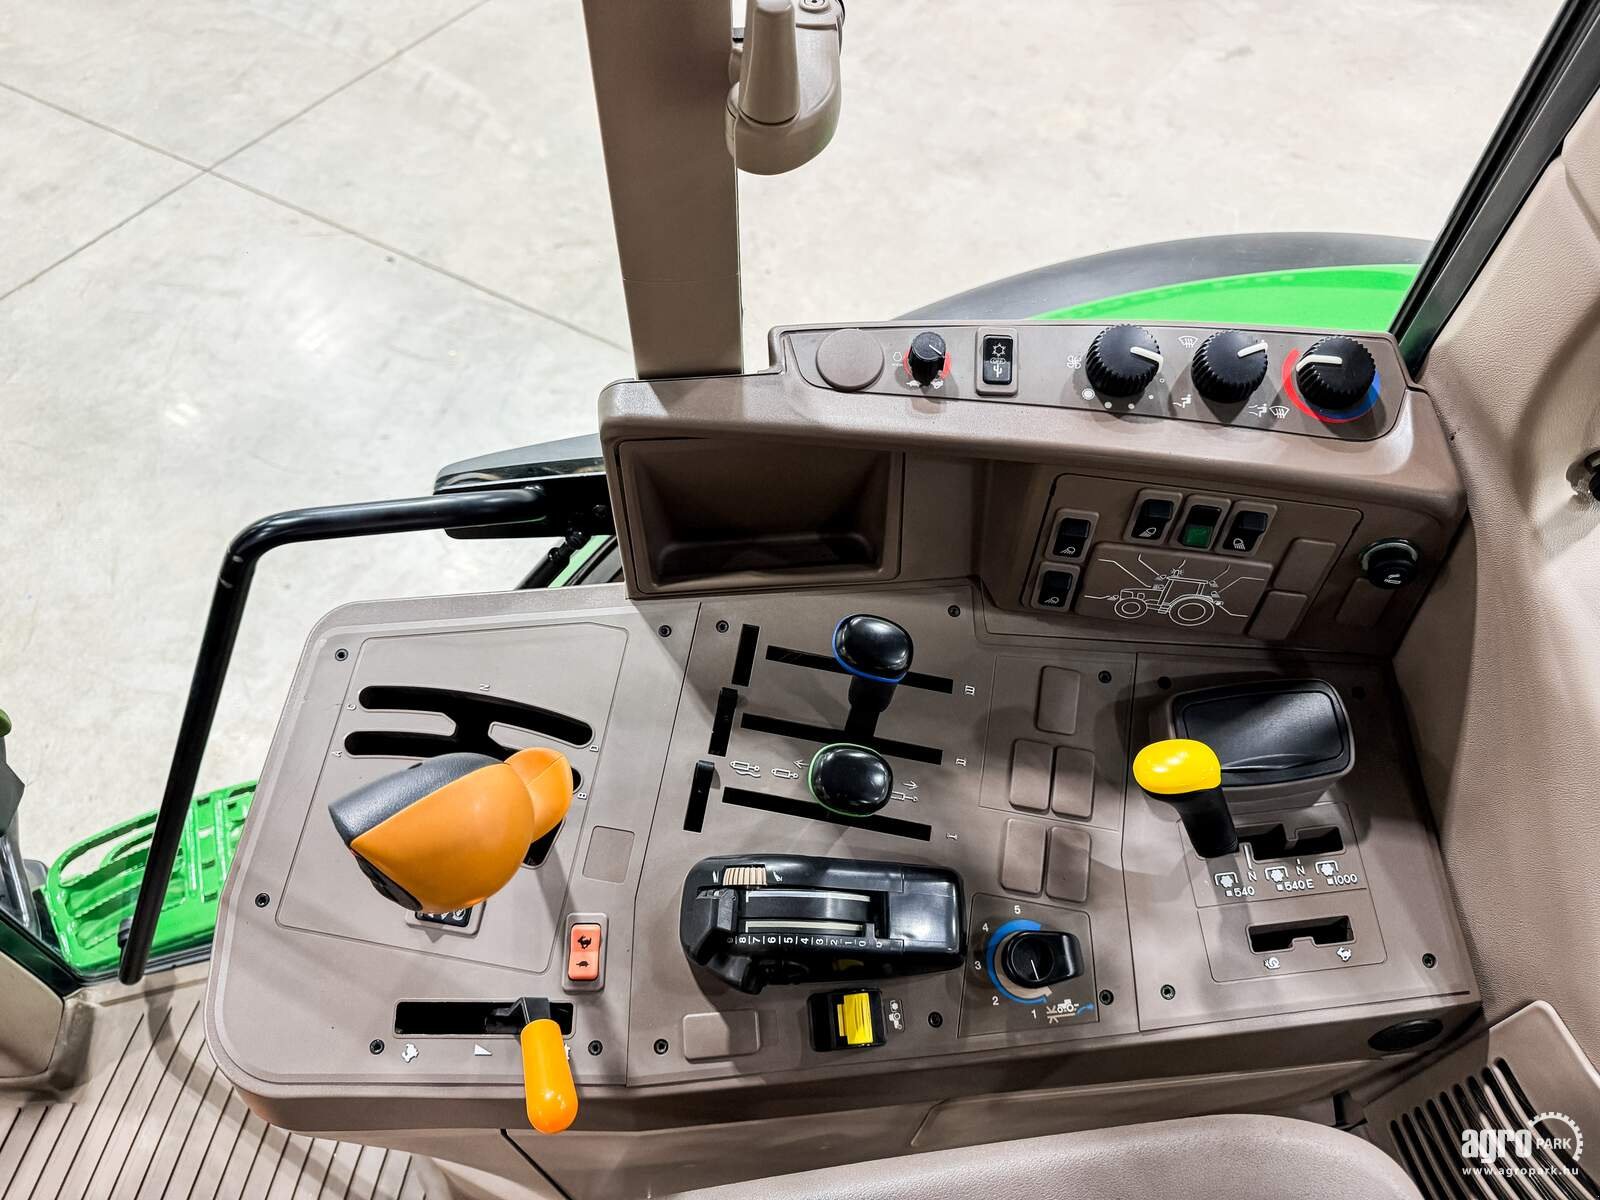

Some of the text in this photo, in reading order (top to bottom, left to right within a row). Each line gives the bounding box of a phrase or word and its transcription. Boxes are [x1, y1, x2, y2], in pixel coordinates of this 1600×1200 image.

[578, 792, 587, 800] B
[1296, 865, 1305, 875] N
[1248, 871, 1257, 881] N
[1284, 880, 1315, 892] 540 E
[1234, 887, 1255, 897] 540
[1014, 905, 1021, 914] 5
[982, 923, 989, 932] 4
[738, 936, 747, 944] 8
[752, 936, 761, 944] 7
[767, 936, 777, 944] 6
[783, 936, 794, 944] 5
[800, 937, 809, 945] 4
[974, 961, 982, 970] 3
[992, 996, 999, 1006] 2
[1031, 1009, 1037, 1019] 1
